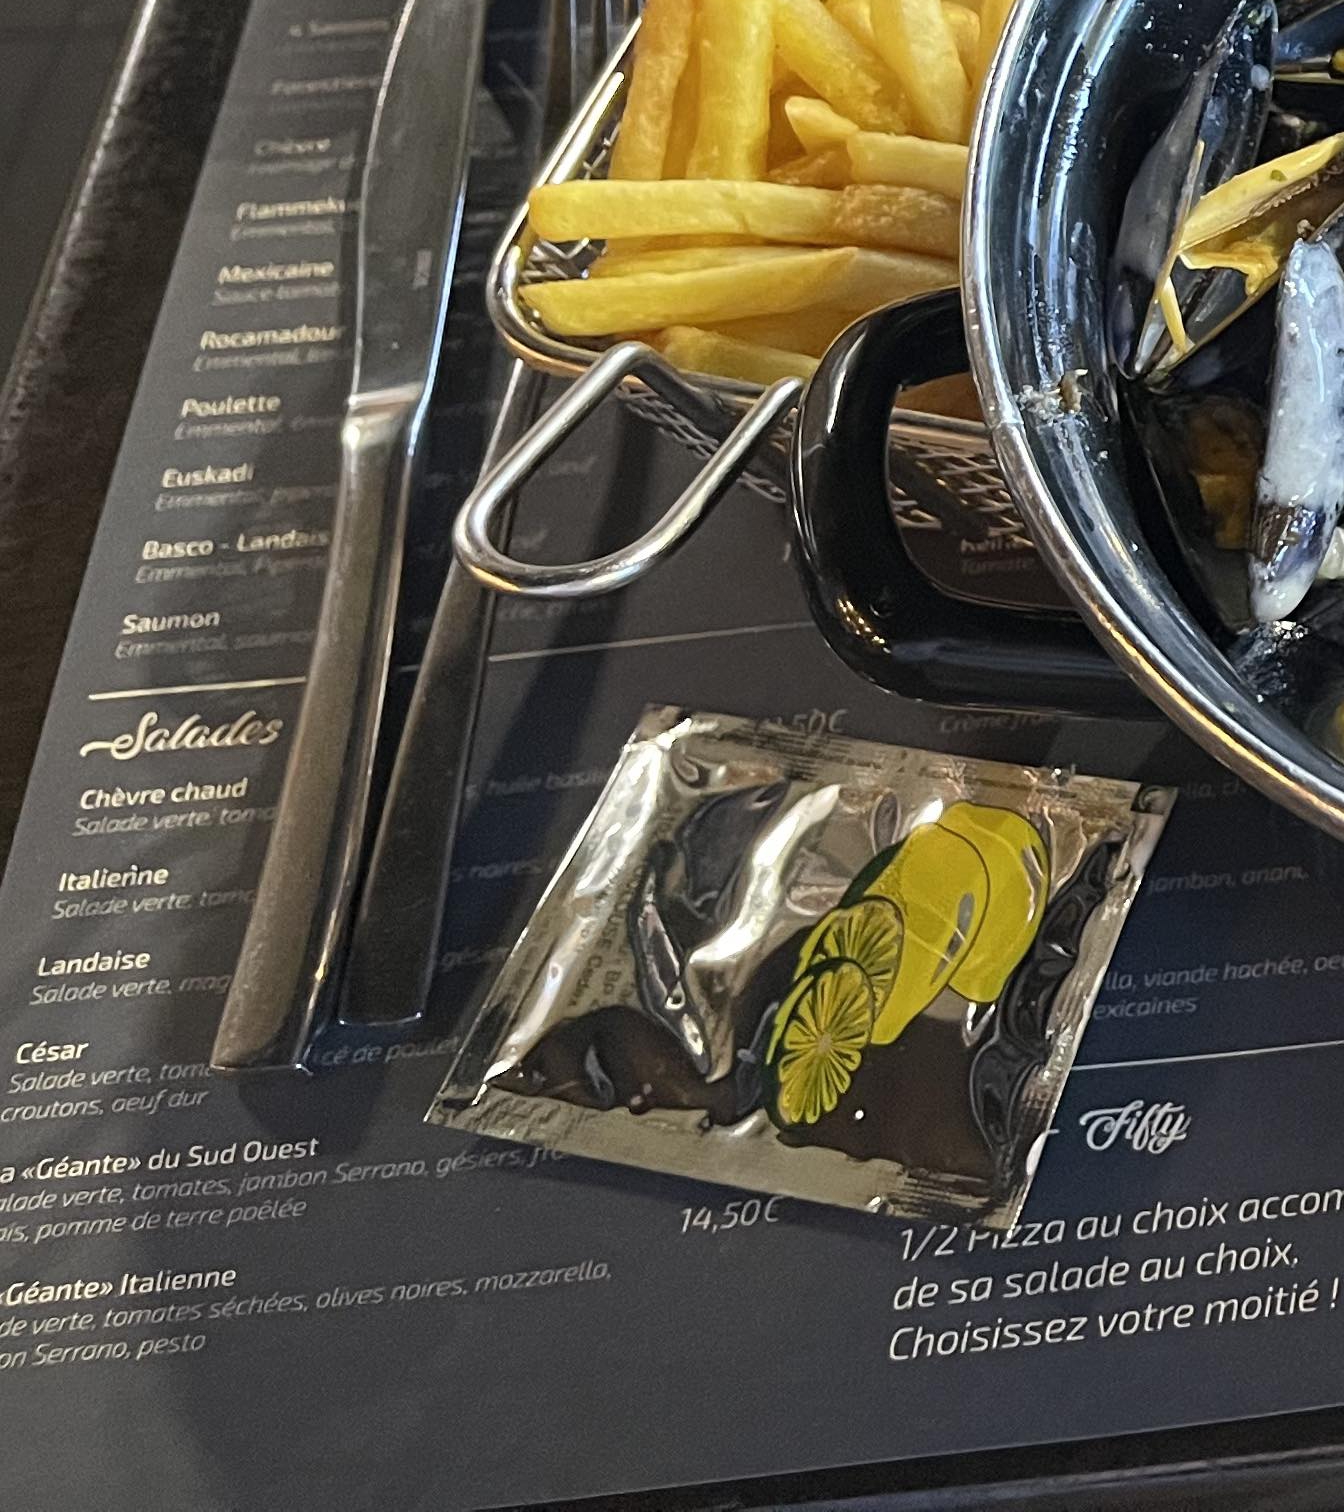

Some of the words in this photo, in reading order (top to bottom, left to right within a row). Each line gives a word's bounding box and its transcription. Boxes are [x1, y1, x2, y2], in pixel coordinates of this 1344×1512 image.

[181, 394, 281, 419] Poulette
[161, 463, 255, 489] Euskadi
[142, 539, 214, 561] Basco
[121, 611, 221, 636] Saumon
[80, 710, 284, 760] Salades
[80, 786, 166, 811] Chèvre
[170, 777, 249, 803] chaud
[58, 864, 170, 892] Italienne
[37, 950, 151, 977] Landaise
[1143, 964, 1218, 988] viande
[1223, 955, 1308, 983] hachée,
[29, 982, 107, 1007] Salade
[1092, 995, 1198, 1020] exicaines
[15, 1040, 90, 1066] César
[8, 1070, 86, 1096] Salade
[0, 1098, 104, 1123] croutons,
[168, 1089, 209, 1109] dur
[1079, 1099, 1192, 1155] Fifty
[148, 1148, 181, 1171] du
[187, 1142, 238, 1168] Sud
[243, 1137, 320, 1163] Ouest
[62, 1186, 125, 1208] verte,
[235, 1170, 328, 1198] jambon
[332, 1161, 430, 1186] Serrano,
[34, 1215, 127, 1245] pomme
[131, 1210, 162, 1231] de
[166, 1209, 223, 1230] terre
[226, 1197, 308, 1227] poêlée
[681, 1198, 783, 1235] 14,50€
[1076, 1214, 1122, 1241] au
[1133, 1196, 1229, 1235] choix
[120, 1268, 238, 1297] Italienne
[893, 1276, 939, 1311] de
[948, 1276, 993, 1306] sa
[1003, 1255, 1129, 1298] salade
[1140, 1254, 1185, 1283] au
[32, 1311, 96, 1335] verte,
[103, 1303, 202, 1329] tomates
[208, 1294, 309, 1321] séchées,
[315, 1287, 385, 1310] olives
[889, 1316, 1088, 1361] Choisissez
[1098, 1302, 1195, 1339] votre
[1204, 1283, 1320, 1326] moitié
[1329, 1277, 1341, 1309] !
[32, 1342, 131, 1367] Serrano,
[136, 1333, 207, 1362] pesto
